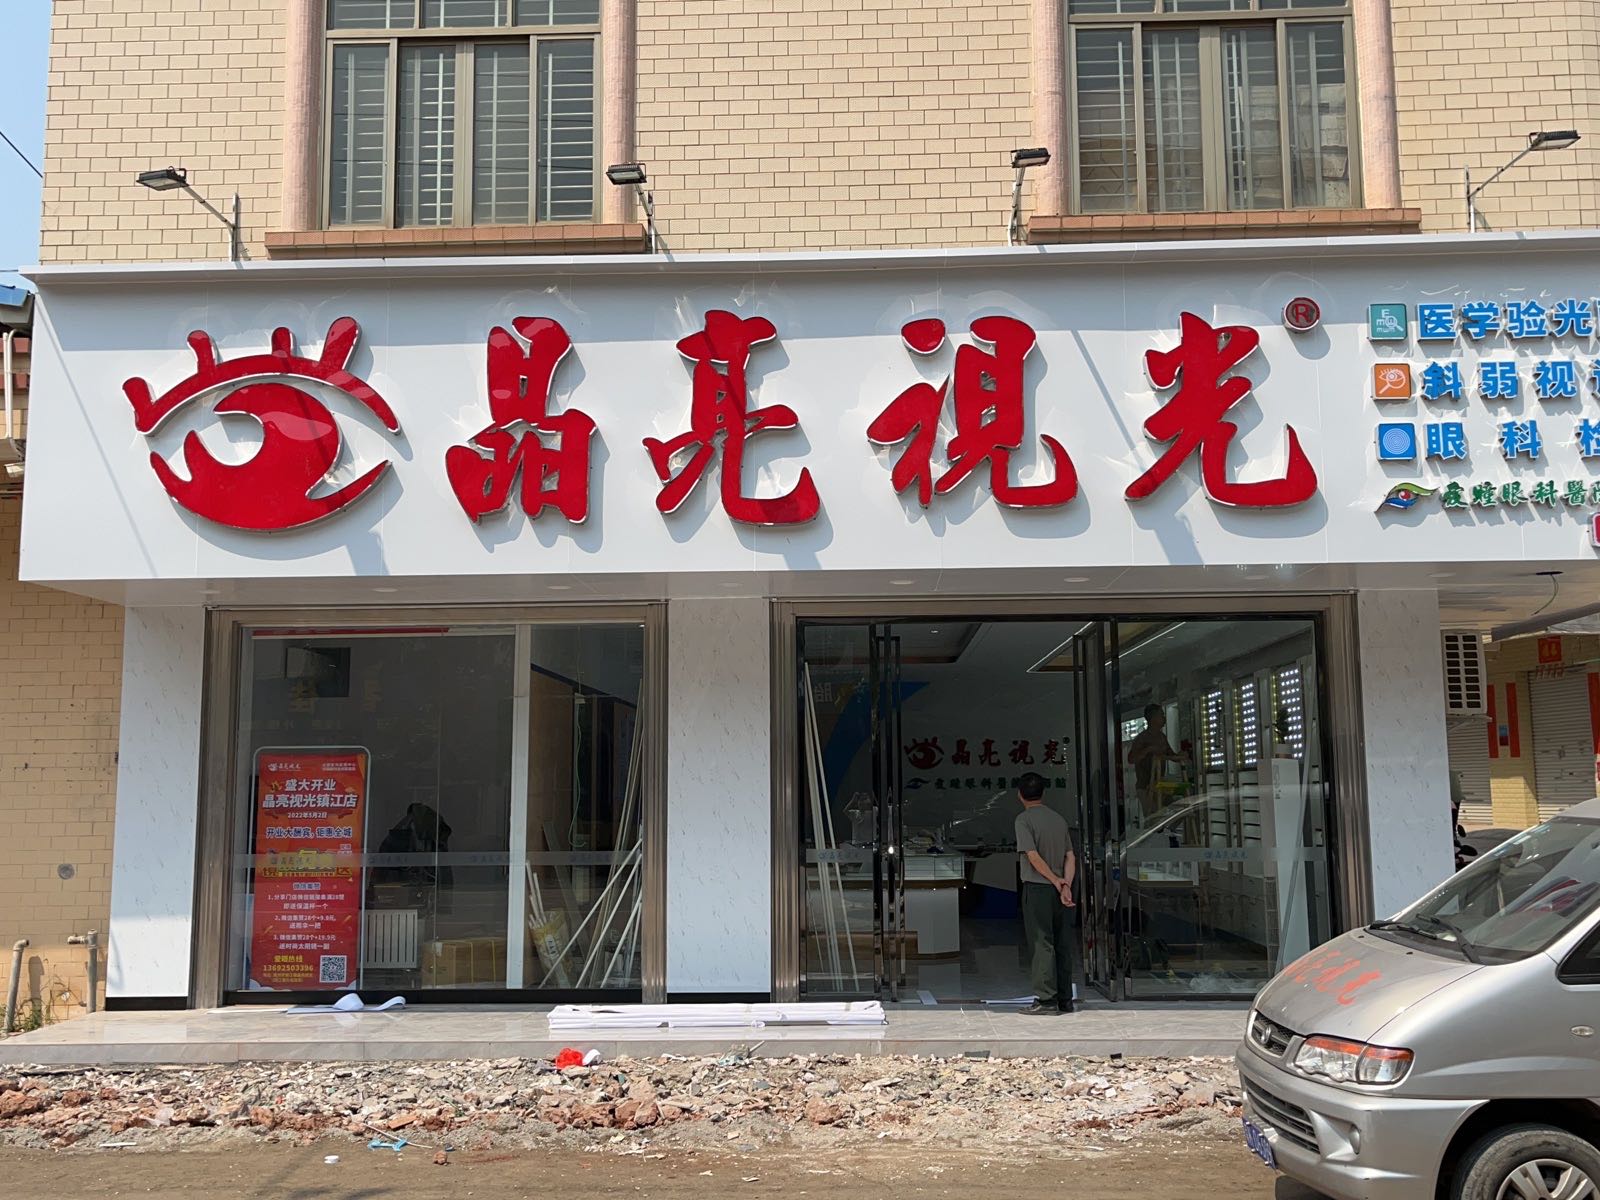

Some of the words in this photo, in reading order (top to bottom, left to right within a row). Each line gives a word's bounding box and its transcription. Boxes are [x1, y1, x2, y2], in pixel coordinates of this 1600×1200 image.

[1417, 300, 1600, 340] 医学验光
[285, 778, 337, 792] 盛大开业
[262, 793, 358, 808] 晶亮视光镇江店
